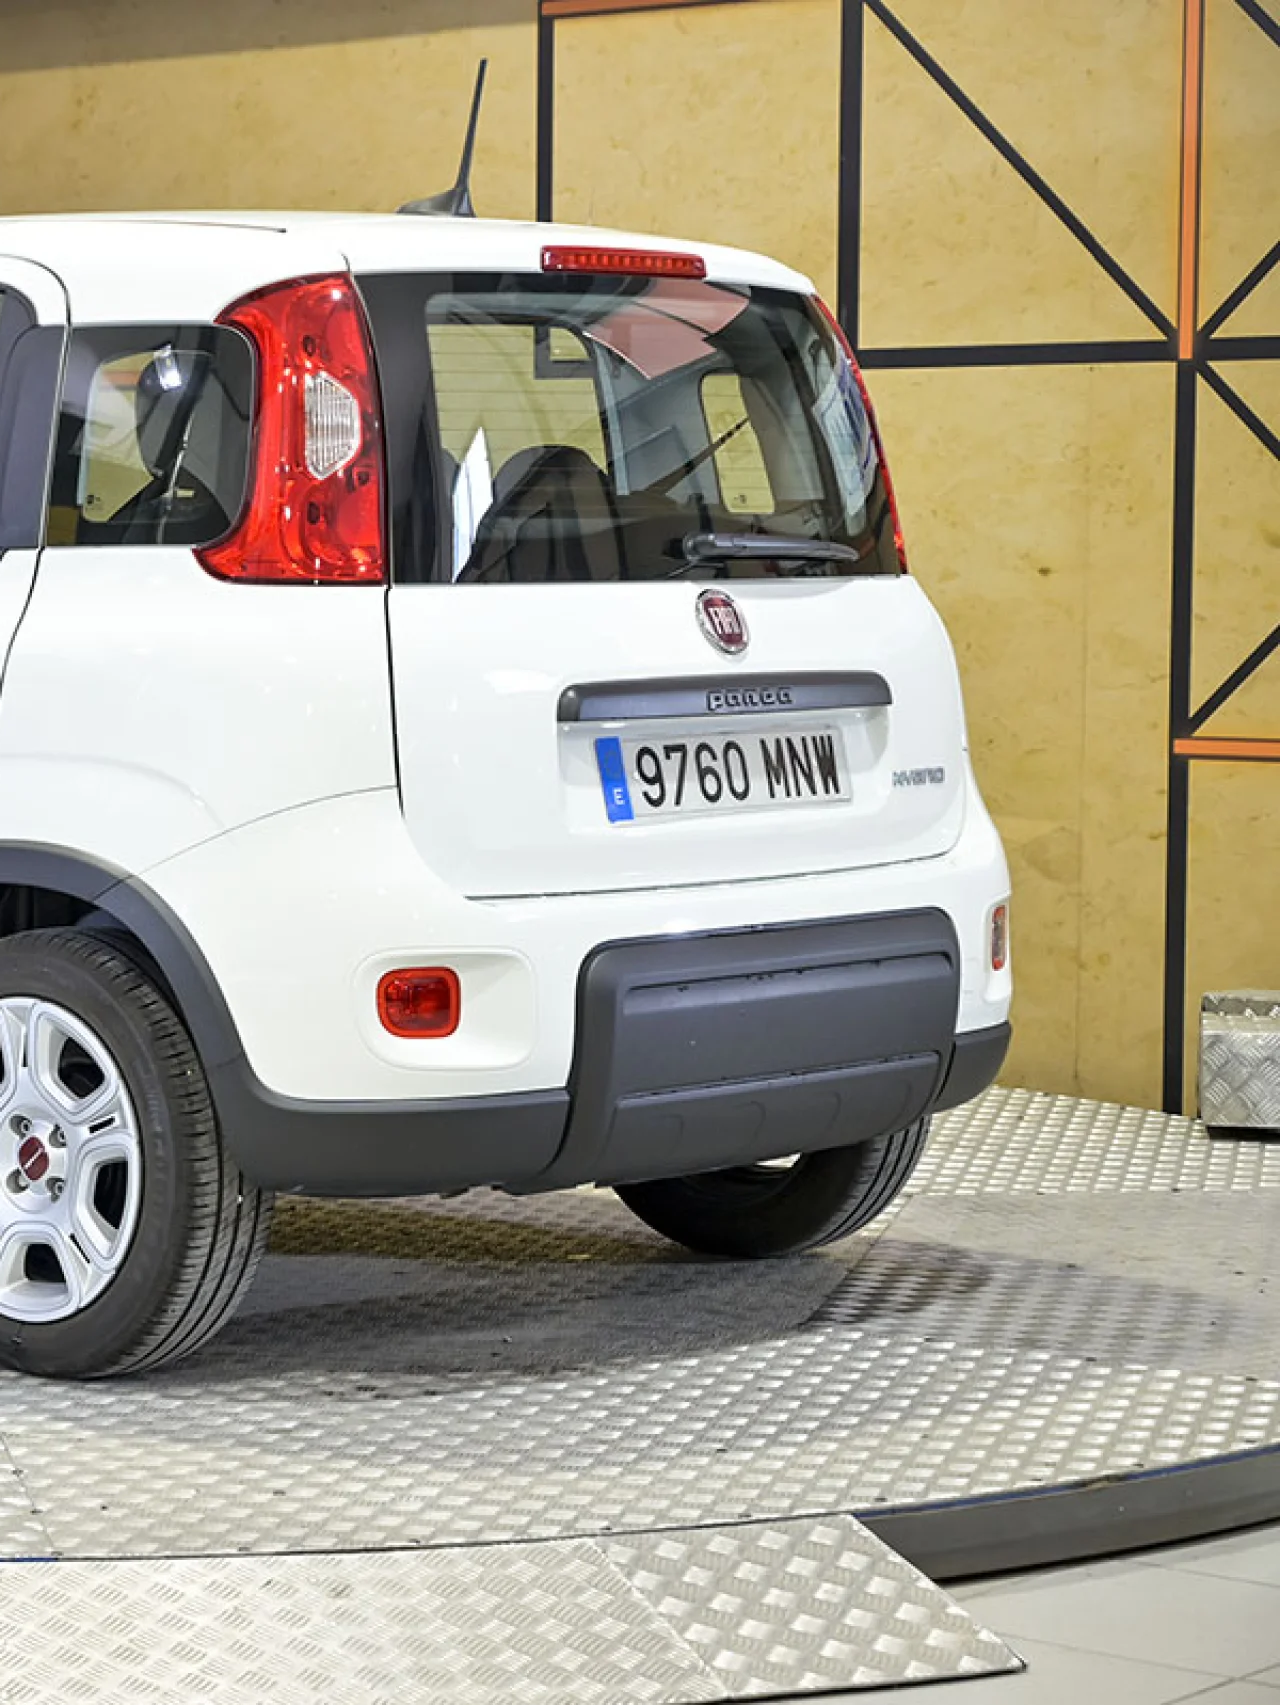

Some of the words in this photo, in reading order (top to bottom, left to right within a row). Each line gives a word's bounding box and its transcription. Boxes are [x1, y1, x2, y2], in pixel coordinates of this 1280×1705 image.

[635, 740, 750, 808] 9760
[760, 734, 840, 799] MNW
[613, 788, 624, 806] E
